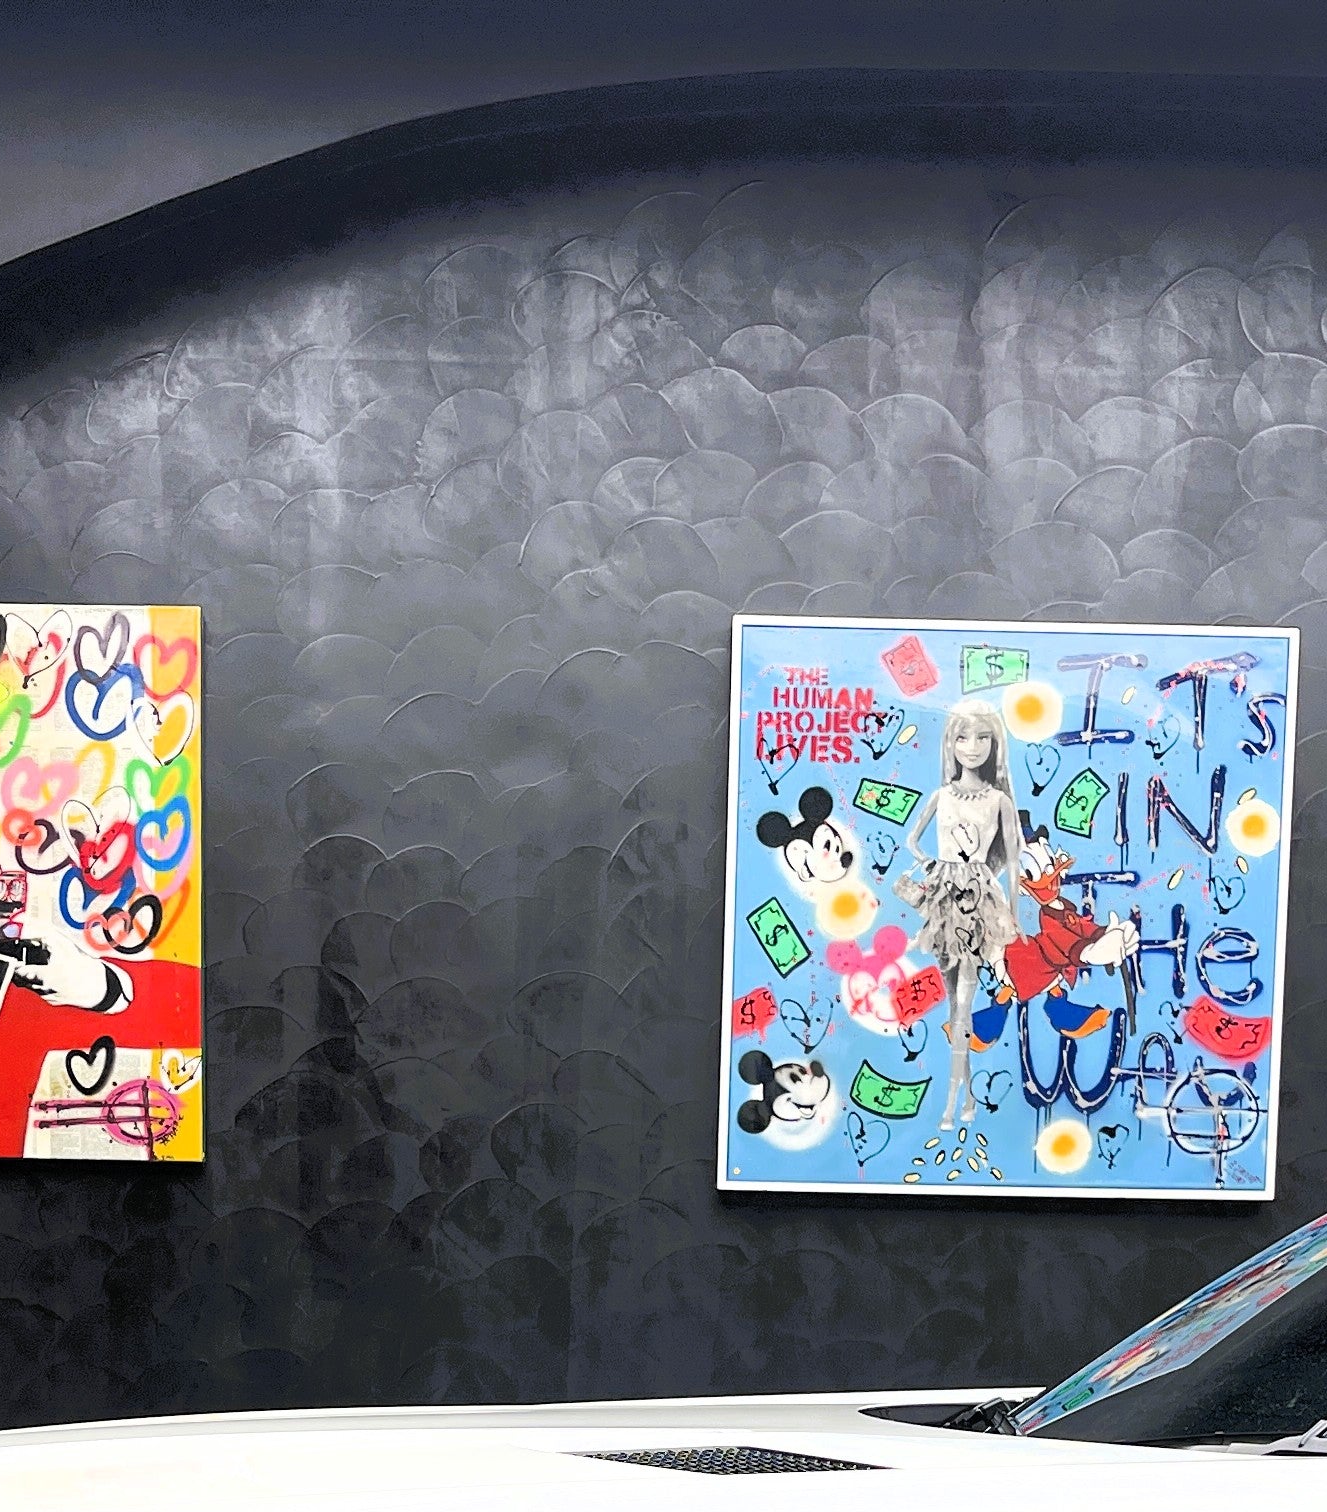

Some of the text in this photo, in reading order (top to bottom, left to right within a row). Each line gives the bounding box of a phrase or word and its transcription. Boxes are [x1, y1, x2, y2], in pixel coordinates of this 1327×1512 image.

[784, 666, 829, 686] THE
[773, 687, 874, 712] HUMAN
[757, 711, 888, 733] PROJECT
[1113, 765, 1228, 858] IN
